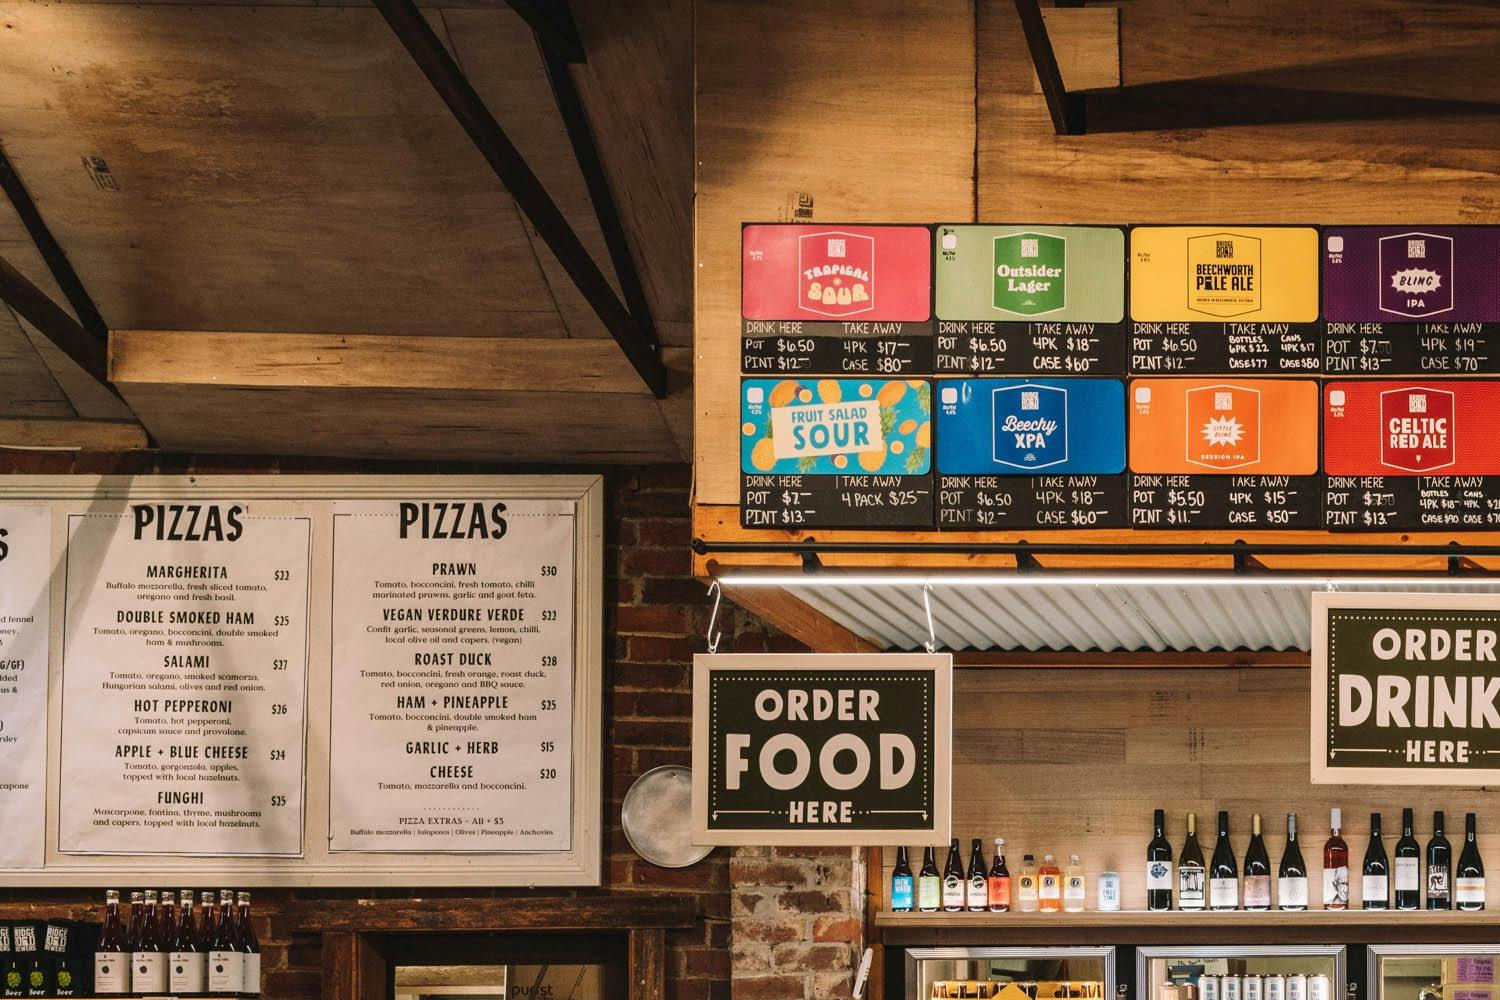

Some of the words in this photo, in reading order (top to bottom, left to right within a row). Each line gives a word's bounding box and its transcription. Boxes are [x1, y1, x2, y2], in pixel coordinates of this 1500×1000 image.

[804, 265, 868, 281] TROPICAL
[997, 265, 1061, 277] Outsider
[1197, 264, 1253, 276] BEECHWORTH
[1008, 279, 1051, 293] Lager
[1232, 277, 1253, 291] ALE
[1400, 276, 1433, 285] BLING
[808, 282, 869, 305] SOUR
[1407, 299, 1425, 308] IPA
[747, 322, 775, 333] DRINK
[780, 322, 802, 333] HERE
[842, 323, 868, 333] TAKE
[873, 323, 901, 334] AWAY
[778, 339, 814, 351] $6.50
[844, 341, 866, 353] 4PK
[938, 338, 957, 349] POT
[970, 337, 1006, 352] $6.50
[1033, 338, 1058, 350] 4PK
[744, 357, 774, 368] PINT
[843, 359, 868, 370] CASE
[1422, 357, 1449, 369] CASE
[792, 410, 824, 423] FRUIT
[829, 408, 867, 421] SALAD
[1002, 415, 1057, 435] Beechy
[1389, 418, 1447, 434] CELTIC
[793, 422, 869, 450] SOUR
[1015, 433, 1045, 448] XPA
[1390, 434, 1419, 448] RED
[1422, 434, 1447, 448] ALE
[941, 492, 964, 505] POT
[977, 492, 1012, 506] $6.50
[1134, 491, 1155, 503] POT
[1168, 490, 1204, 506] $5.50
[134, 505, 243, 542] PIZZAS
[400, 503, 507, 539] PIZZAS
[1464, 515, 1482, 523] CASE
[147, 566, 228, 578] MARGHERITA
[274, 570, 289, 581] $22
[433, 563, 476, 575] PRAWN
[542, 566, 557, 576] $30
[117, 611, 163, 623] DOUBLE
[170, 612, 220, 624] SMOKED
[226, 613, 254, 624] HAM
[274, 616, 289, 626] $25
[383, 609, 422, 621] VEGAN
[428, 609, 482, 621] VERDURE
[487, 609, 524, 621] VERDE
[542, 611, 557, 620] $22
[385, 636, 406, 644] local
[492, 636, 522, 645] (vegan)
[1373, 628, 1497, 661] ORDER
[164, 656, 209, 668] SALAMI
[273, 660, 287, 670] $27
[415, 654, 453, 665] ROAST
[460, 654, 492, 665] DUCK
[542, 656, 557, 666] $28
[480, 681, 498, 689] BBQ
[135, 700, 158, 712] HOT
[165, 701, 231, 713] PEPPERONI
[272, 705, 287, 714] $26
[398, 696, 425, 708] HAM
[444, 696, 508, 708] PINEAPPLE
[542, 700, 556, 710] $25
[755, 689, 879, 721] ORDER
[115, 745, 151, 757] APPLE
[170, 746, 198, 758] BLUE
[205, 747, 248, 759] CHEESE
[271, 750, 285, 761] $24
[406, 742, 449, 754] GARLIC
[468, 742, 498, 754] HERB
[541, 742, 554, 752] $15
[1406, 740, 1469, 763] HERE
[726, 733, 916, 790] FOOD
[430, 766, 473, 778] CHEESE
[540, 769, 556, 779] $20
[158, 792, 203, 804] FUNGHI
[272, 796, 286, 806] $25
[790, 801, 852, 823] HERE
